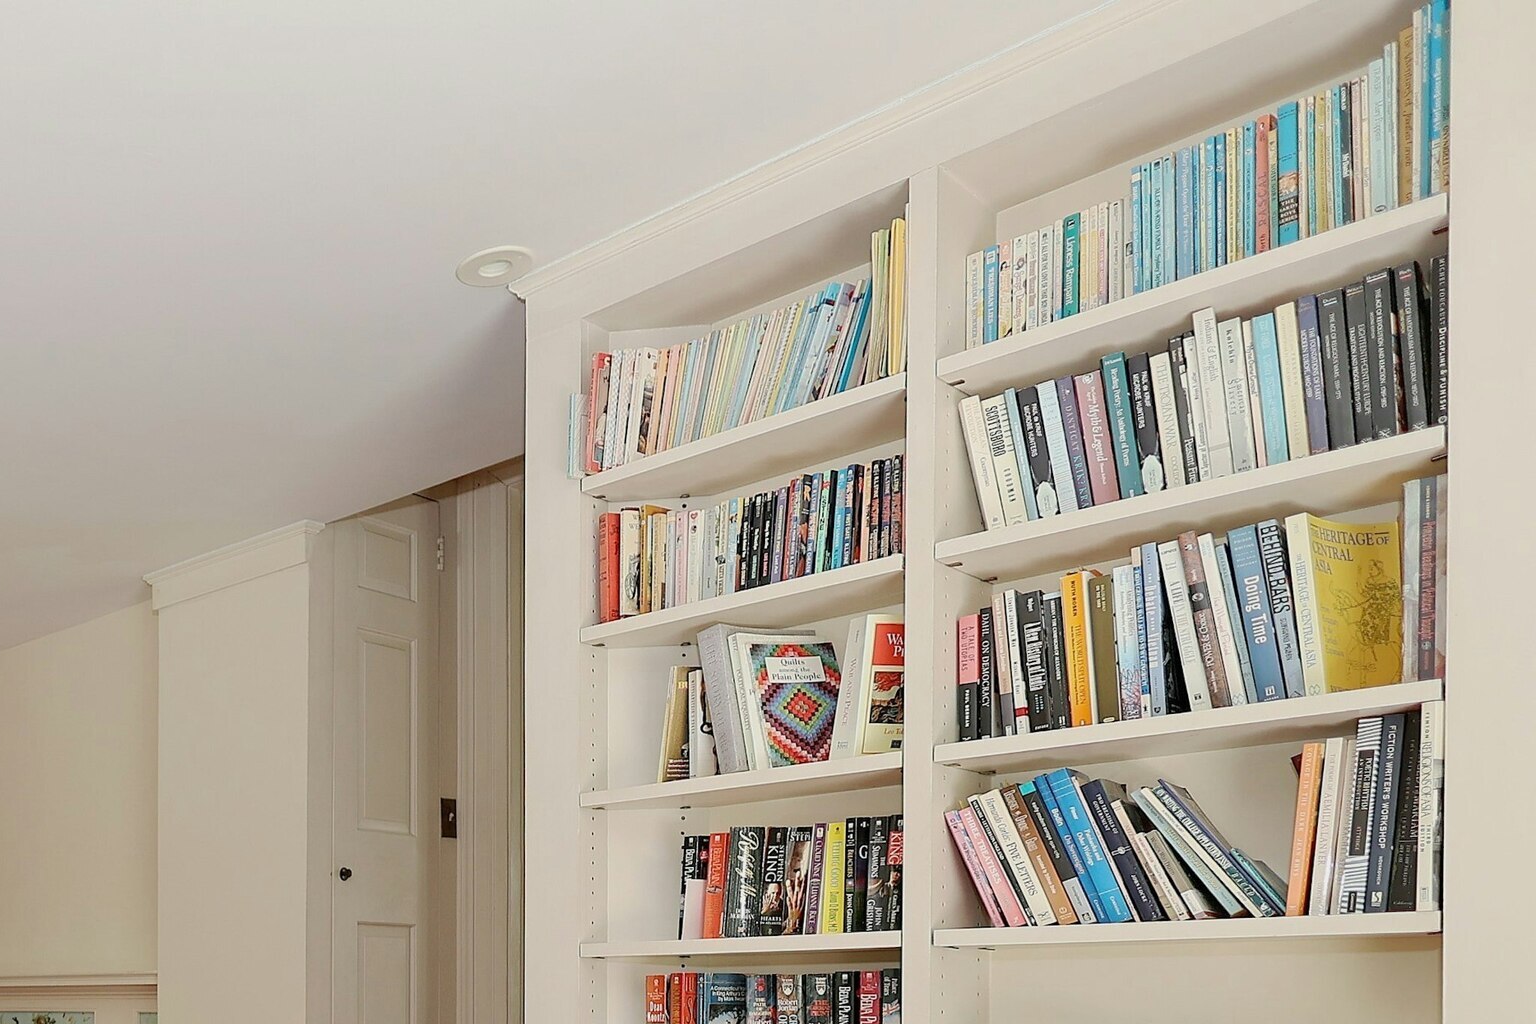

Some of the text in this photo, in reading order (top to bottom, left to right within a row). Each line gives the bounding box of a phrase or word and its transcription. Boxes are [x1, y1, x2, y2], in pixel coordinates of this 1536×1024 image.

[1064, 236, 1075, 305] Lioness Rampant
[1204, 318, 1219, 382] Indians English
[1132, 373, 1146, 429] MICROBE HUNTERS
[1438, 377, 1448, 411] PUNISH
[985, 405, 1007, 457] SCOTTSBORO
[1023, 406, 1038, 458] MICROBE HUNTERS
[1065, 406, 1079, 450] DANTICAT
[1089, 405, 1109, 462] Myth Legend
[1164, 423, 1177, 449] WAR
[1183, 438, 1195, 465] Peasant
[1312, 541, 1354, 562] CENTRAL
[1319, 530, 1390, 546] HERITAGE OF
[1260, 524, 1291, 614] BEHIND BARS
[1315, 559, 1333, 576] ASIA
[1243, 575, 1269, 645] Doing Time
[1294, 561, 1317, 670] HERITAGE CENTRAL ASIA
[780, 658, 805, 667] Quilts
[981, 612, 990, 707] DAHL ON DEMOCRACY
[771, 671, 822, 682] Plain People
[1364, 758, 1373, 781] POETIC
[1421, 742, 1433, 785] RELIGIONS
[1377, 725, 1397, 849] FICTION WRITER'S WORKSHOP
[1050, 808, 1064, 827] Bodin
[1420, 799, 1432, 818] ASIA
[764, 844, 779, 882] KING
[776, 844, 784, 882] STEPHEN
[858, 844, 868, 859] G
[871, 845, 881, 878] SUMMONS
[889, 831, 902, 865] KING
[964, 810, 1002, 885] THREE TREATISES
[984, 797, 1038, 897] Hernando FIVE LETTERS
[1068, 845, 1085, 875] Sovereignty
[808, 861, 822, 926] NINE RICE
[1130, 874, 1148, 902] JOHN LOCKE
[866, 899, 876, 931] GRISHAM
[875, 905, 883, 926] JOHN
[649, 1001, 663, 1012] Dean
[838, 986, 851, 1005] BELVA
[860, 993, 877, 1016] BELVA
[647, 1012, 665, 1022] Koontz
